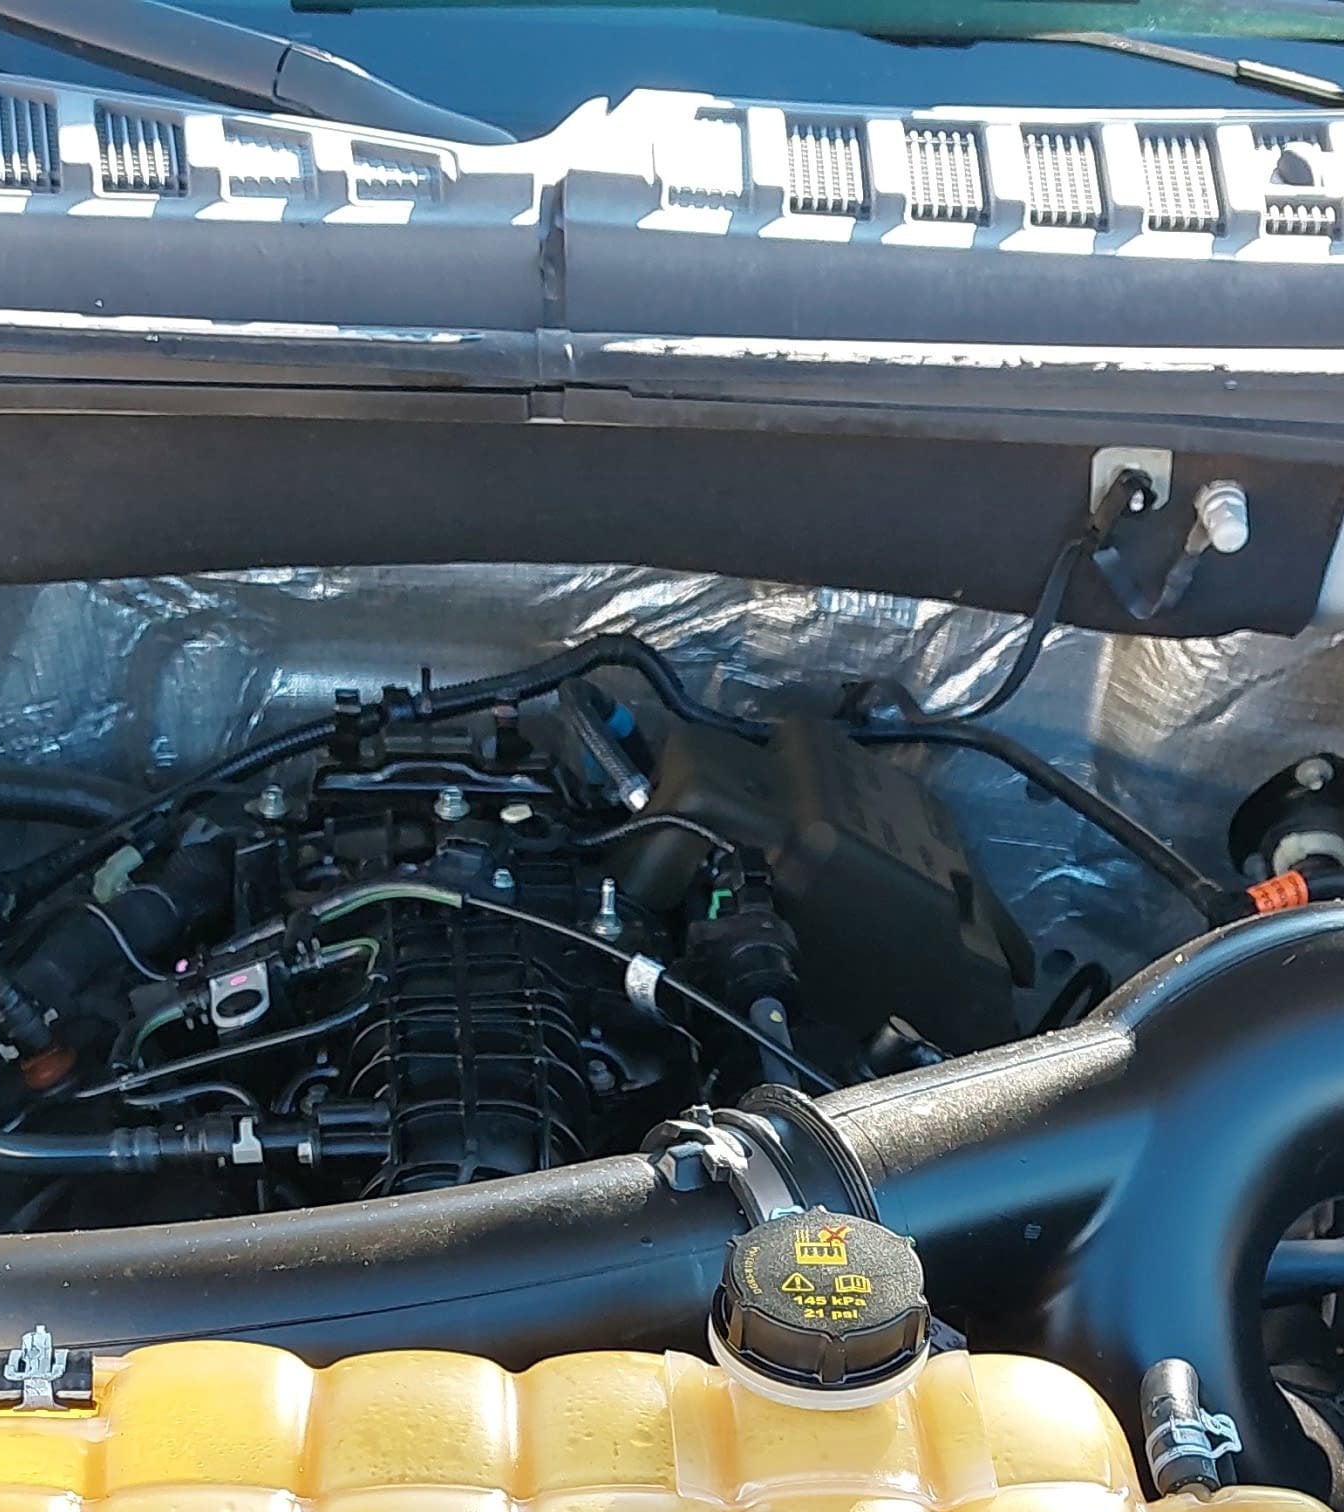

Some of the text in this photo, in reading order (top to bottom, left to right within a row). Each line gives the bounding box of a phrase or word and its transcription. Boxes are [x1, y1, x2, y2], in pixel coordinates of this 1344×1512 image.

[793, 1295, 867, 1306] 145 kPa
[804, 1308, 858, 1320] 21 psi
